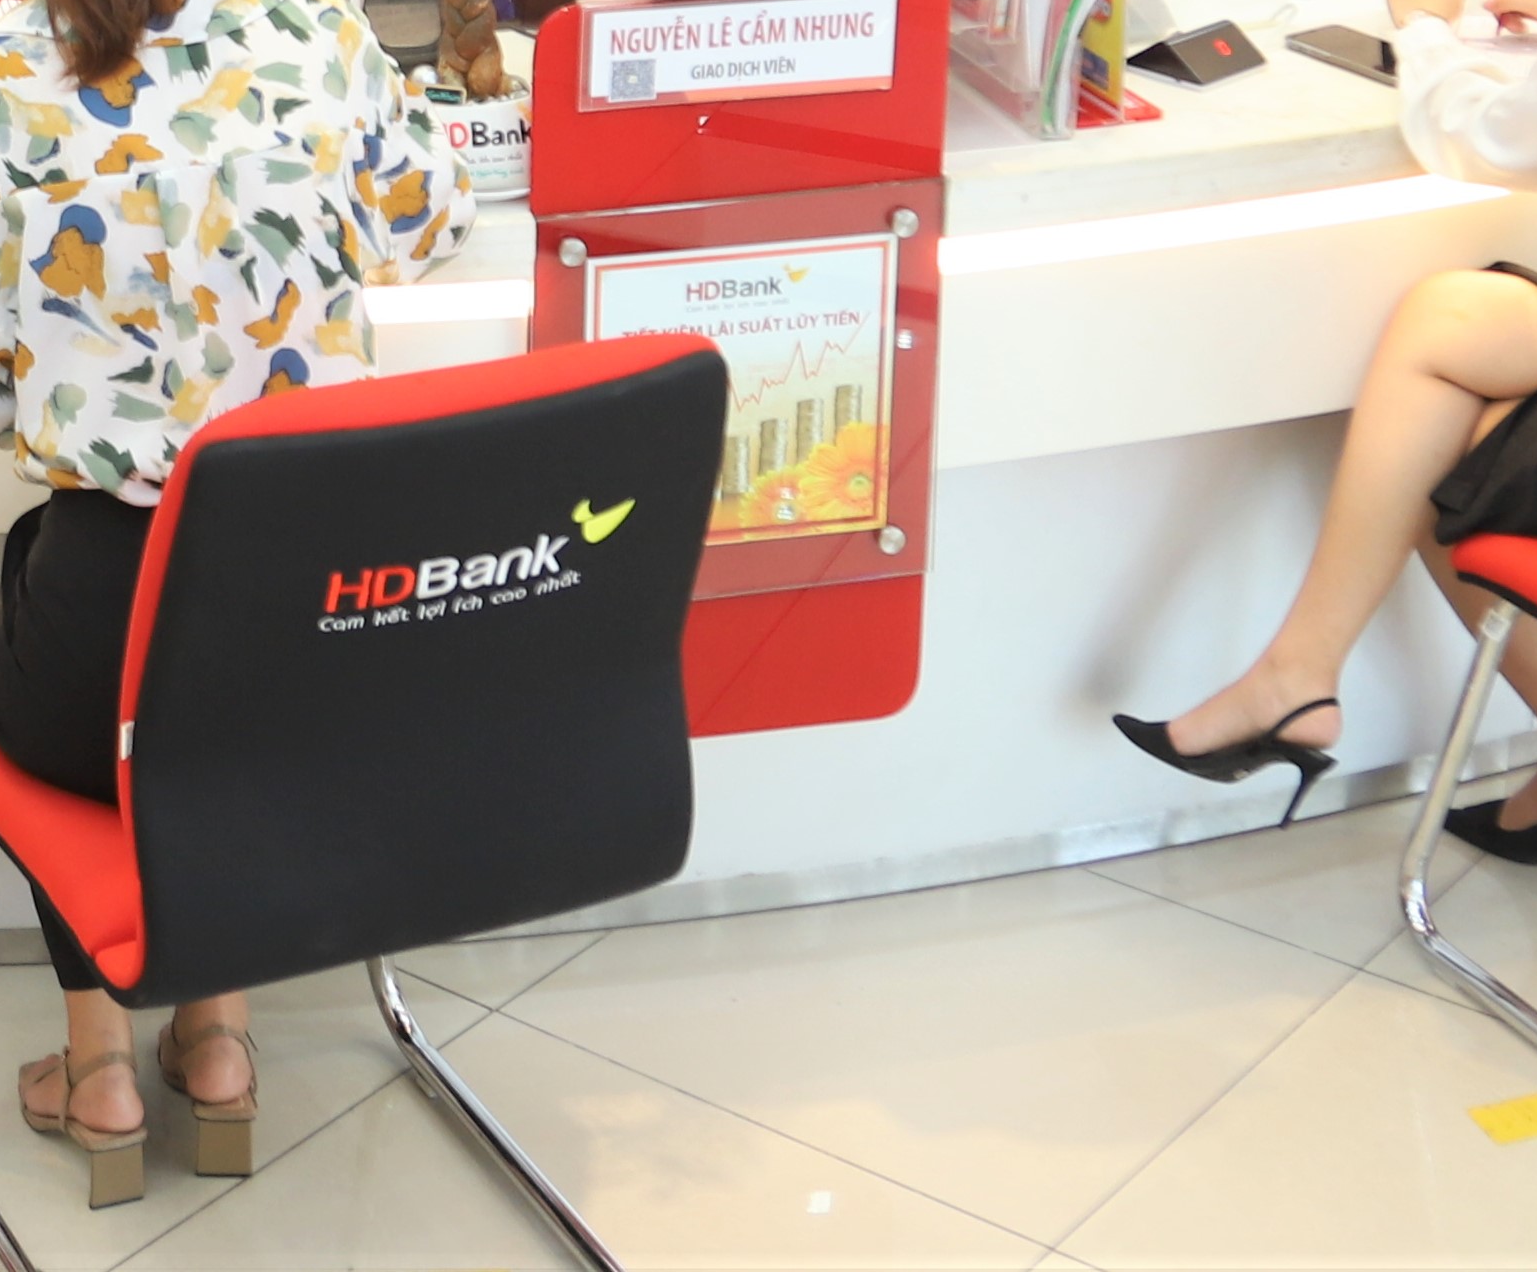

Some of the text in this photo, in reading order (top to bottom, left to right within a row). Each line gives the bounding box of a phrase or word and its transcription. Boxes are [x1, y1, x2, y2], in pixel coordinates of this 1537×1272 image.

[610, 11, 875, 55] NGUYỄN LÊ CẨM NHUNG
[691, 58, 796, 81] GIAO DỊCH VIÊN
[449, 119, 531, 148] DBank
[686, 276, 783, 302] HDBank
[708, 322, 734, 338] LÃI
[739, 316, 783, 335] SUẤT
[325, 533, 571, 613] HDBank
[317, 569, 581, 632] Cam kết lợi ích cao nhất
